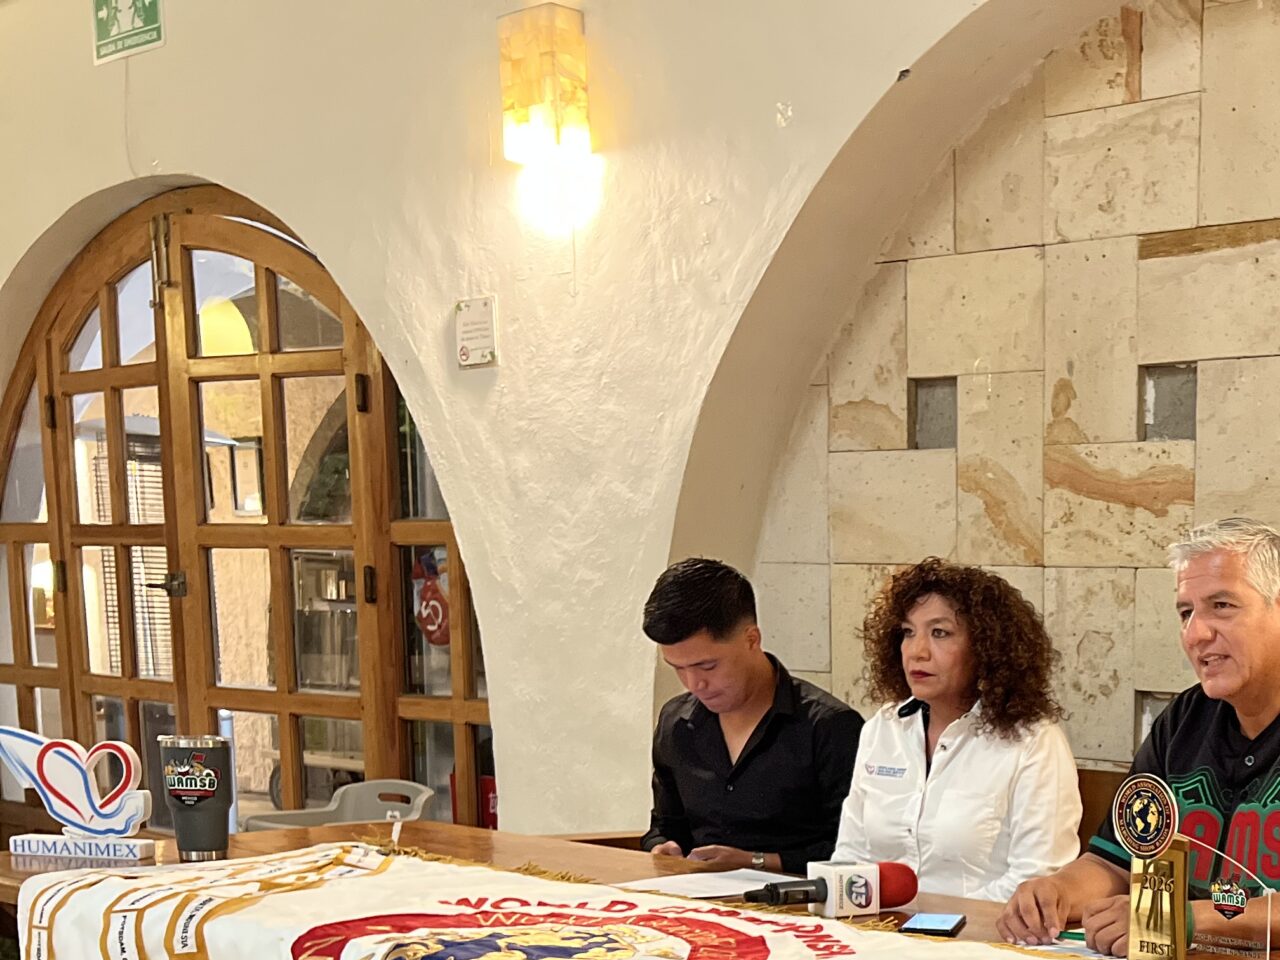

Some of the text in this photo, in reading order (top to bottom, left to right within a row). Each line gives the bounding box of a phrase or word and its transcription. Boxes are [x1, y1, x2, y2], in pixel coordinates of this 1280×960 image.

[167, 775, 217, 790] WAMSB
[13, 838, 138, 859] HUMANIMEX
[1142, 874, 1174, 893] 2026
[1213, 893, 1246, 906] WAMSB
[1139, 940, 1174, 957] FIRST
